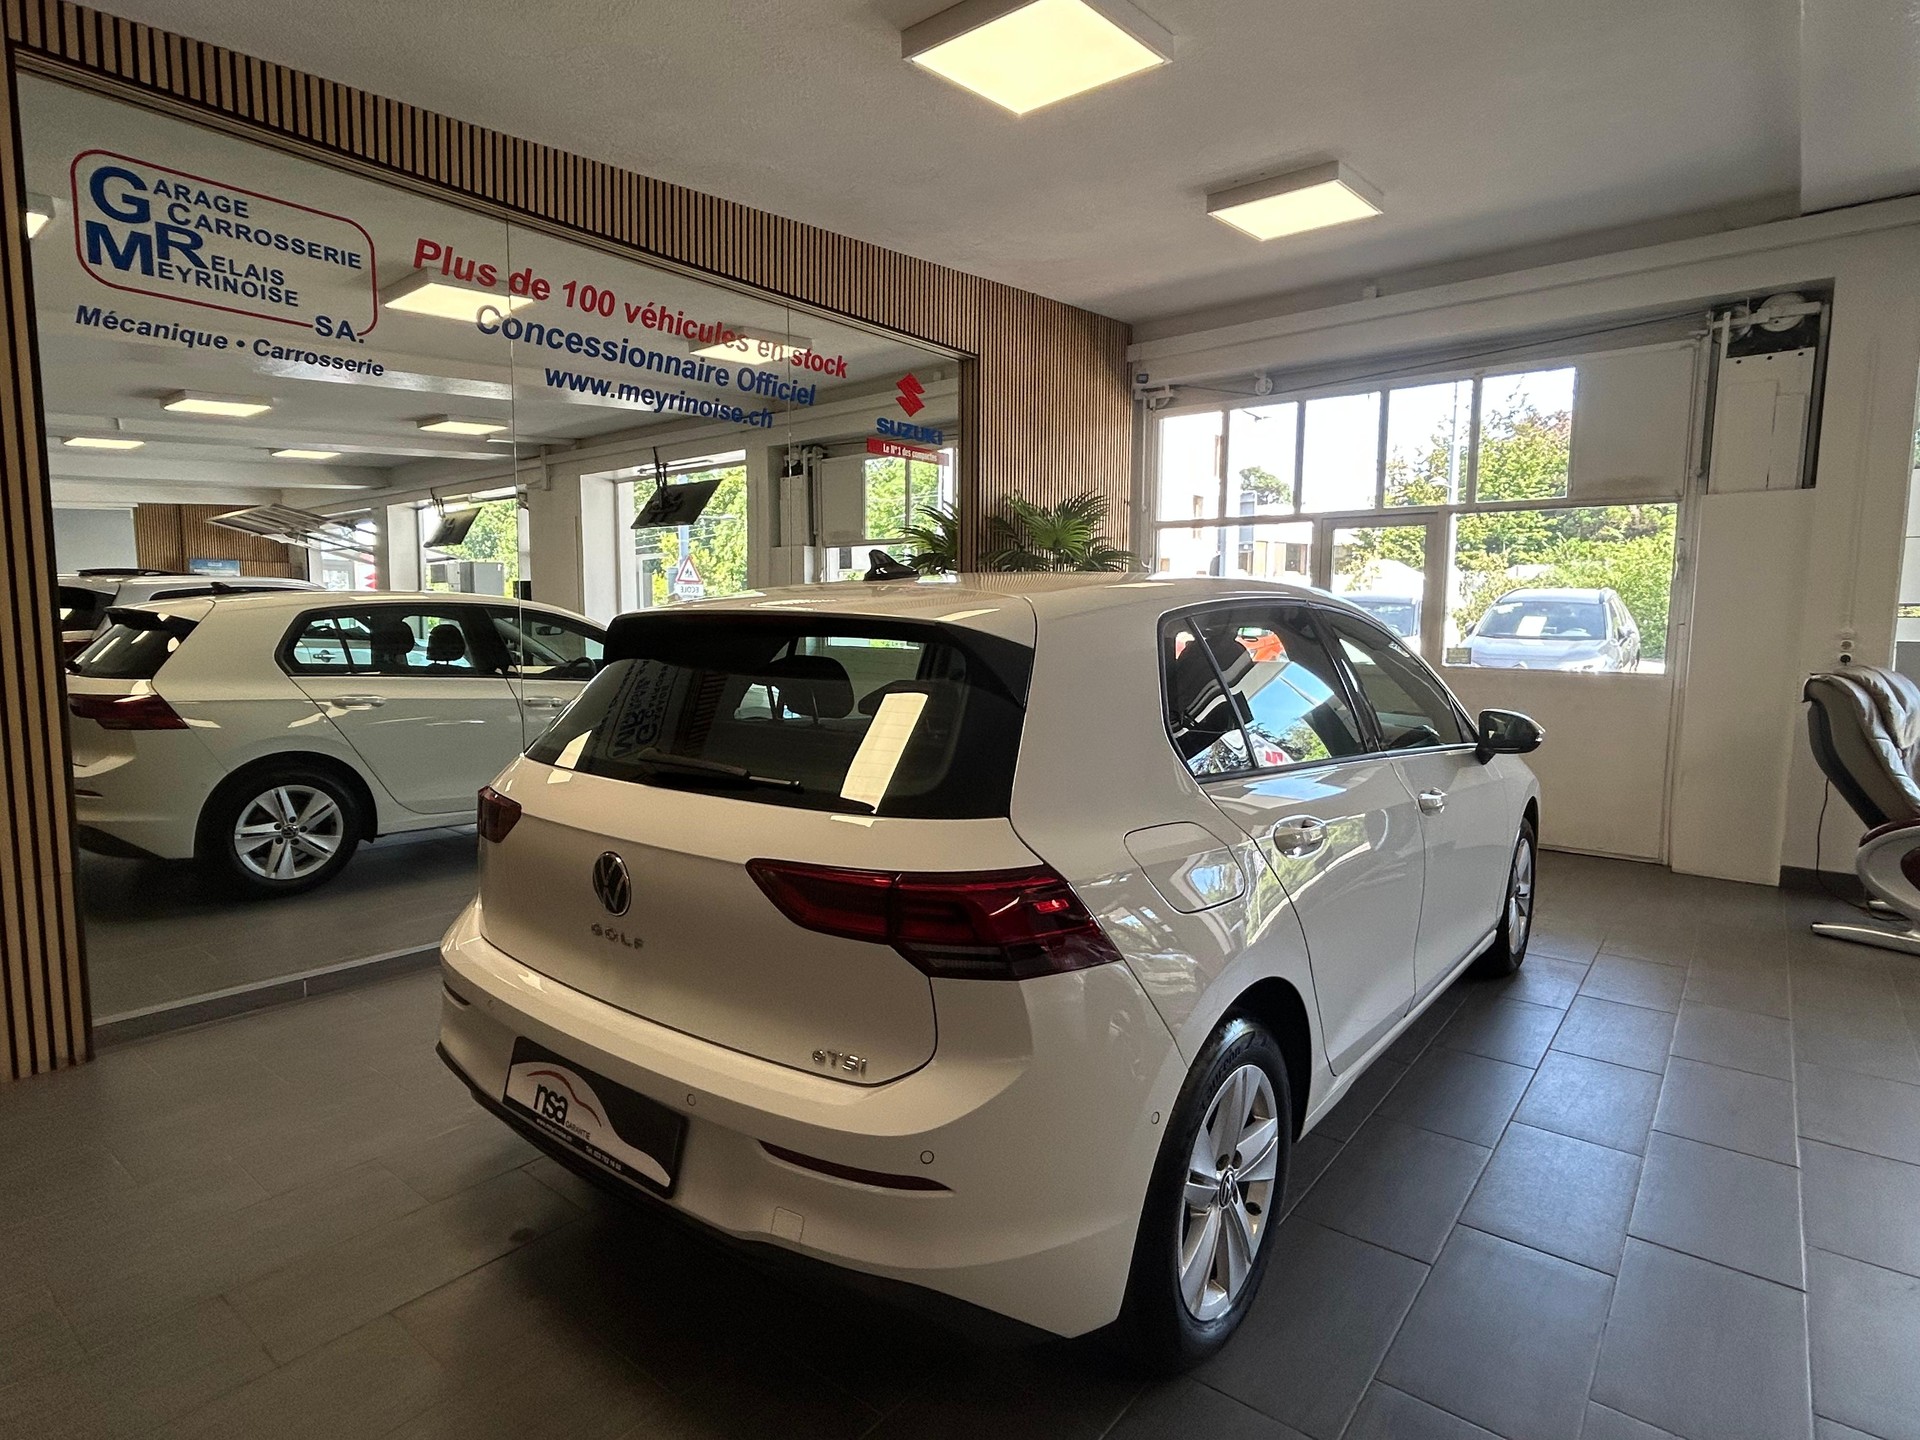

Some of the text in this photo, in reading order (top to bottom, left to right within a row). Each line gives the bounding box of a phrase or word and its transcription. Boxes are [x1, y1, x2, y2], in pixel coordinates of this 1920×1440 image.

[168, 204, 362, 269] CARROSSERIE
[413, 238, 848, 379] Plus de 100 véhicules en stock
[75, 305, 384, 377] Mécanique Carrosserie
[476, 305, 816, 406] Concessionnaire Officiel
[545, 367, 773, 428] www.meyrinoise.ch
[876, 417, 943, 445] SUZUKI
[591, 922, 643, 949] GOLF
[534, 1083, 568, 1125] nsa
